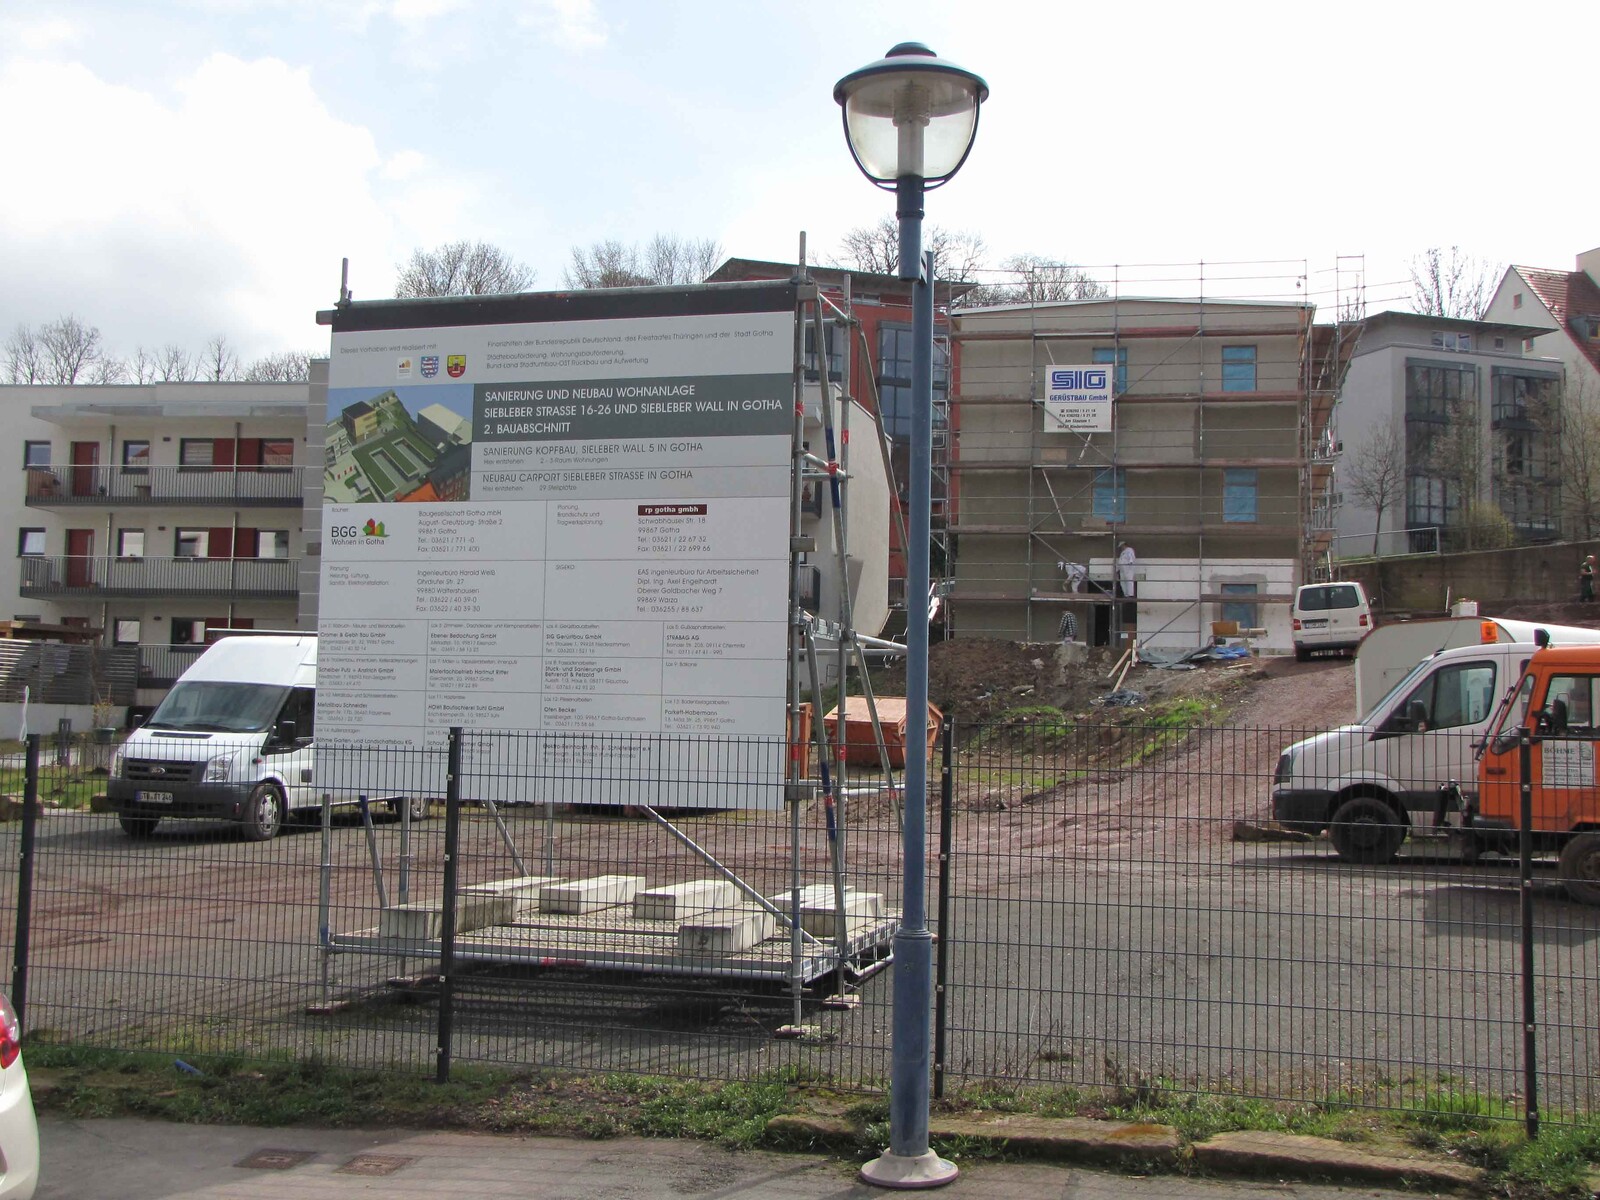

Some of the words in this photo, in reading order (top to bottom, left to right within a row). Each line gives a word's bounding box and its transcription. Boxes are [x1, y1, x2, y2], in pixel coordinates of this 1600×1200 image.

[535, 337, 581, 347] Bundesrepublik
[1052, 371, 1106, 390] SIG
[485, 390, 544, 402] SANIERUNG
[547, 389, 569, 400] UND
[573, 388, 613, 399] NEUBAU
[616, 385, 695, 398] WOHNANLAGE
[484, 407, 533, 418] SIEBLEBER
[536, 406, 577, 417] STRASSE
[582, 405, 611, 416] 16-26
[615, 404, 638, 415] UND
[641, 403, 692, 414] SIEBLEBER
[695, 402, 724, 412] WALL
[727, 401, 739, 412] IN
[742, 400, 783, 411] GOTHA
[484, 425, 493, 434] 2.
[497, 422, 571, 434] BAUABSCHNITT
[483, 446, 533, 456] SANIERUNG
[536, 445, 578, 457] KOPFBAU,
[582, 444, 620, 454] SIELEBER
[622, 444, 645, 453] WALL
[649, 444, 655, 452] 5
[658, 443, 667, 452] IN
[670, 442, 703, 452] GOTHA
[482, 473, 517, 482] NEUBAU
[519, 473, 560, 482] CARPORT
[563, 472, 606, 481] SIEBLEBER
[609, 471, 644, 480] STRASSE
[648, 471, 657, 480] IN
[660, 470, 693, 480] GOTHA
[645, 506, 653, 515] rp
[655, 506, 676, 515] gotha
[678, 506, 699, 515] gmbh
[331, 526, 357, 538] BGG
